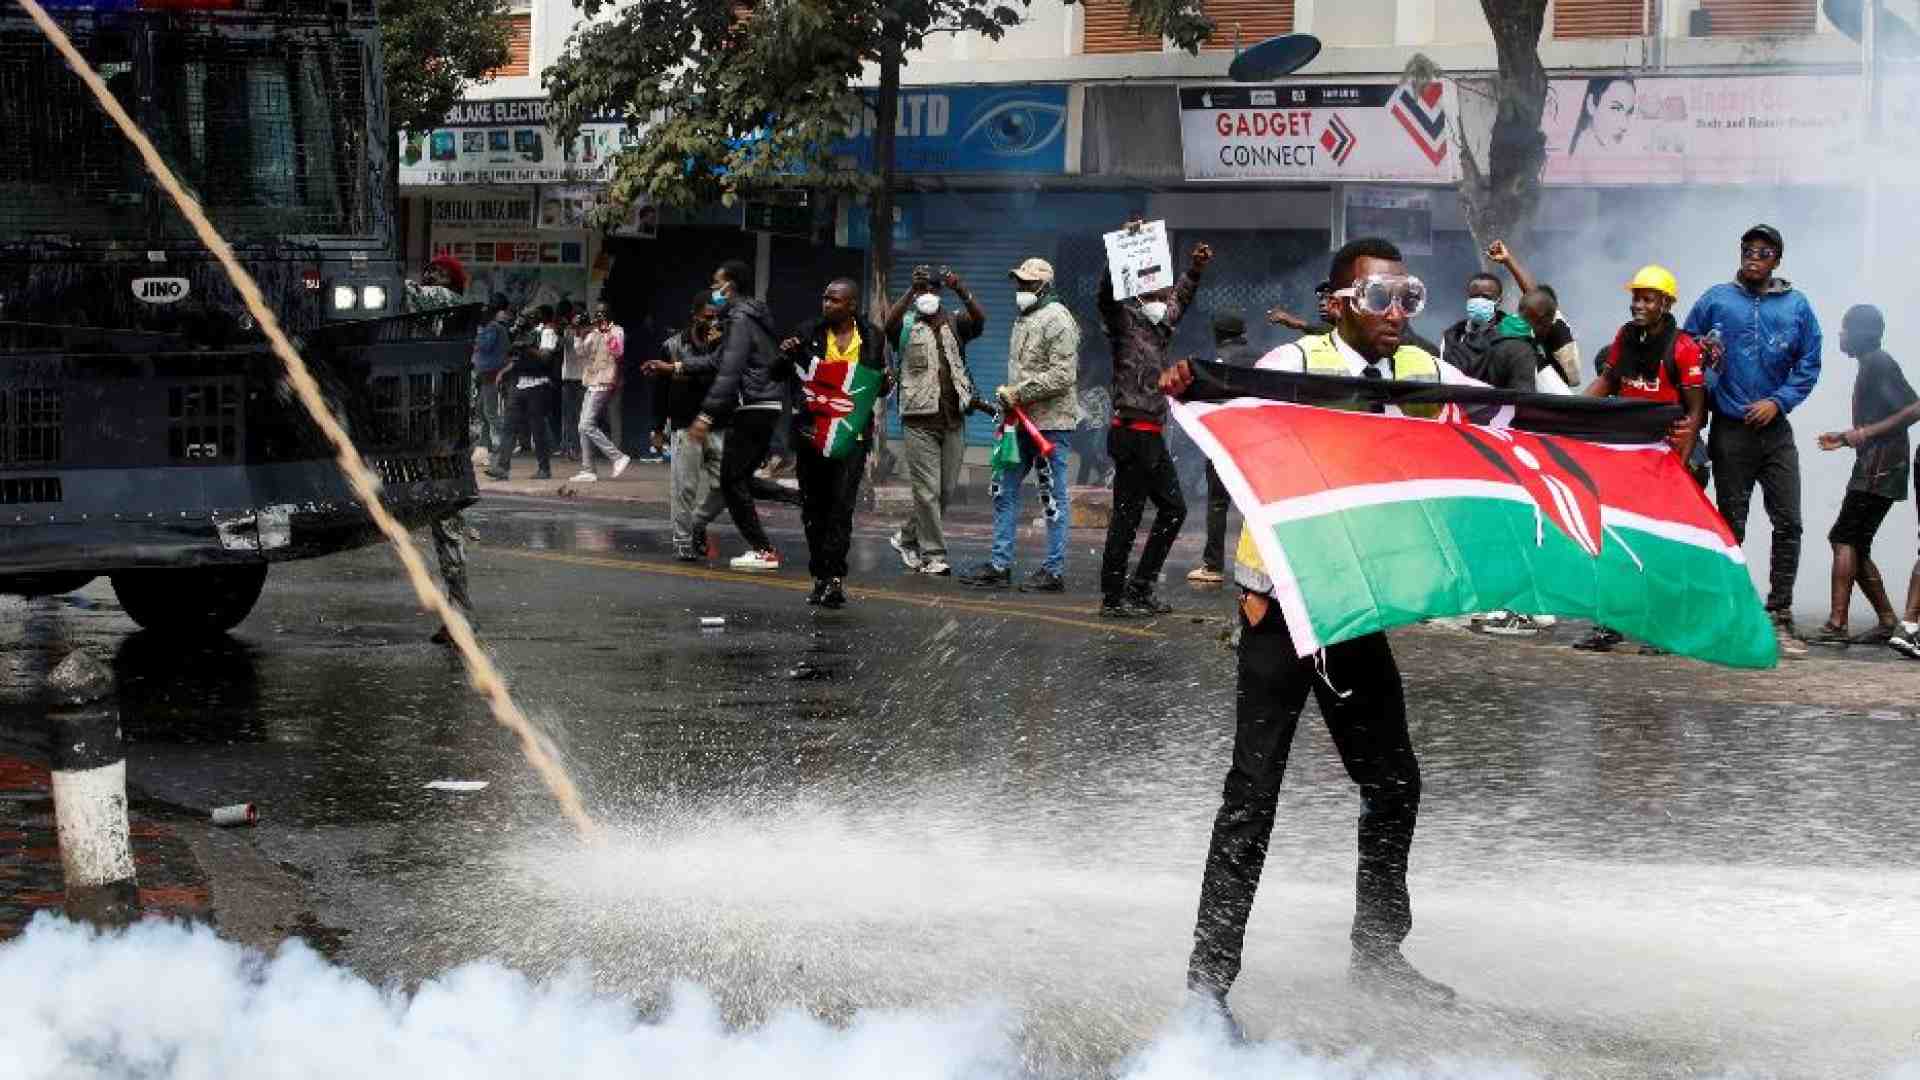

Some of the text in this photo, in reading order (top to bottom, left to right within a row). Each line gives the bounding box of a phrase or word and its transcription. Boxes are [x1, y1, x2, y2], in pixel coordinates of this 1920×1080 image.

[895, 95, 950, 137] LTD
[1216, 112, 1313, 137] GADGET
[1219, 145, 1316, 167] CONNECT
